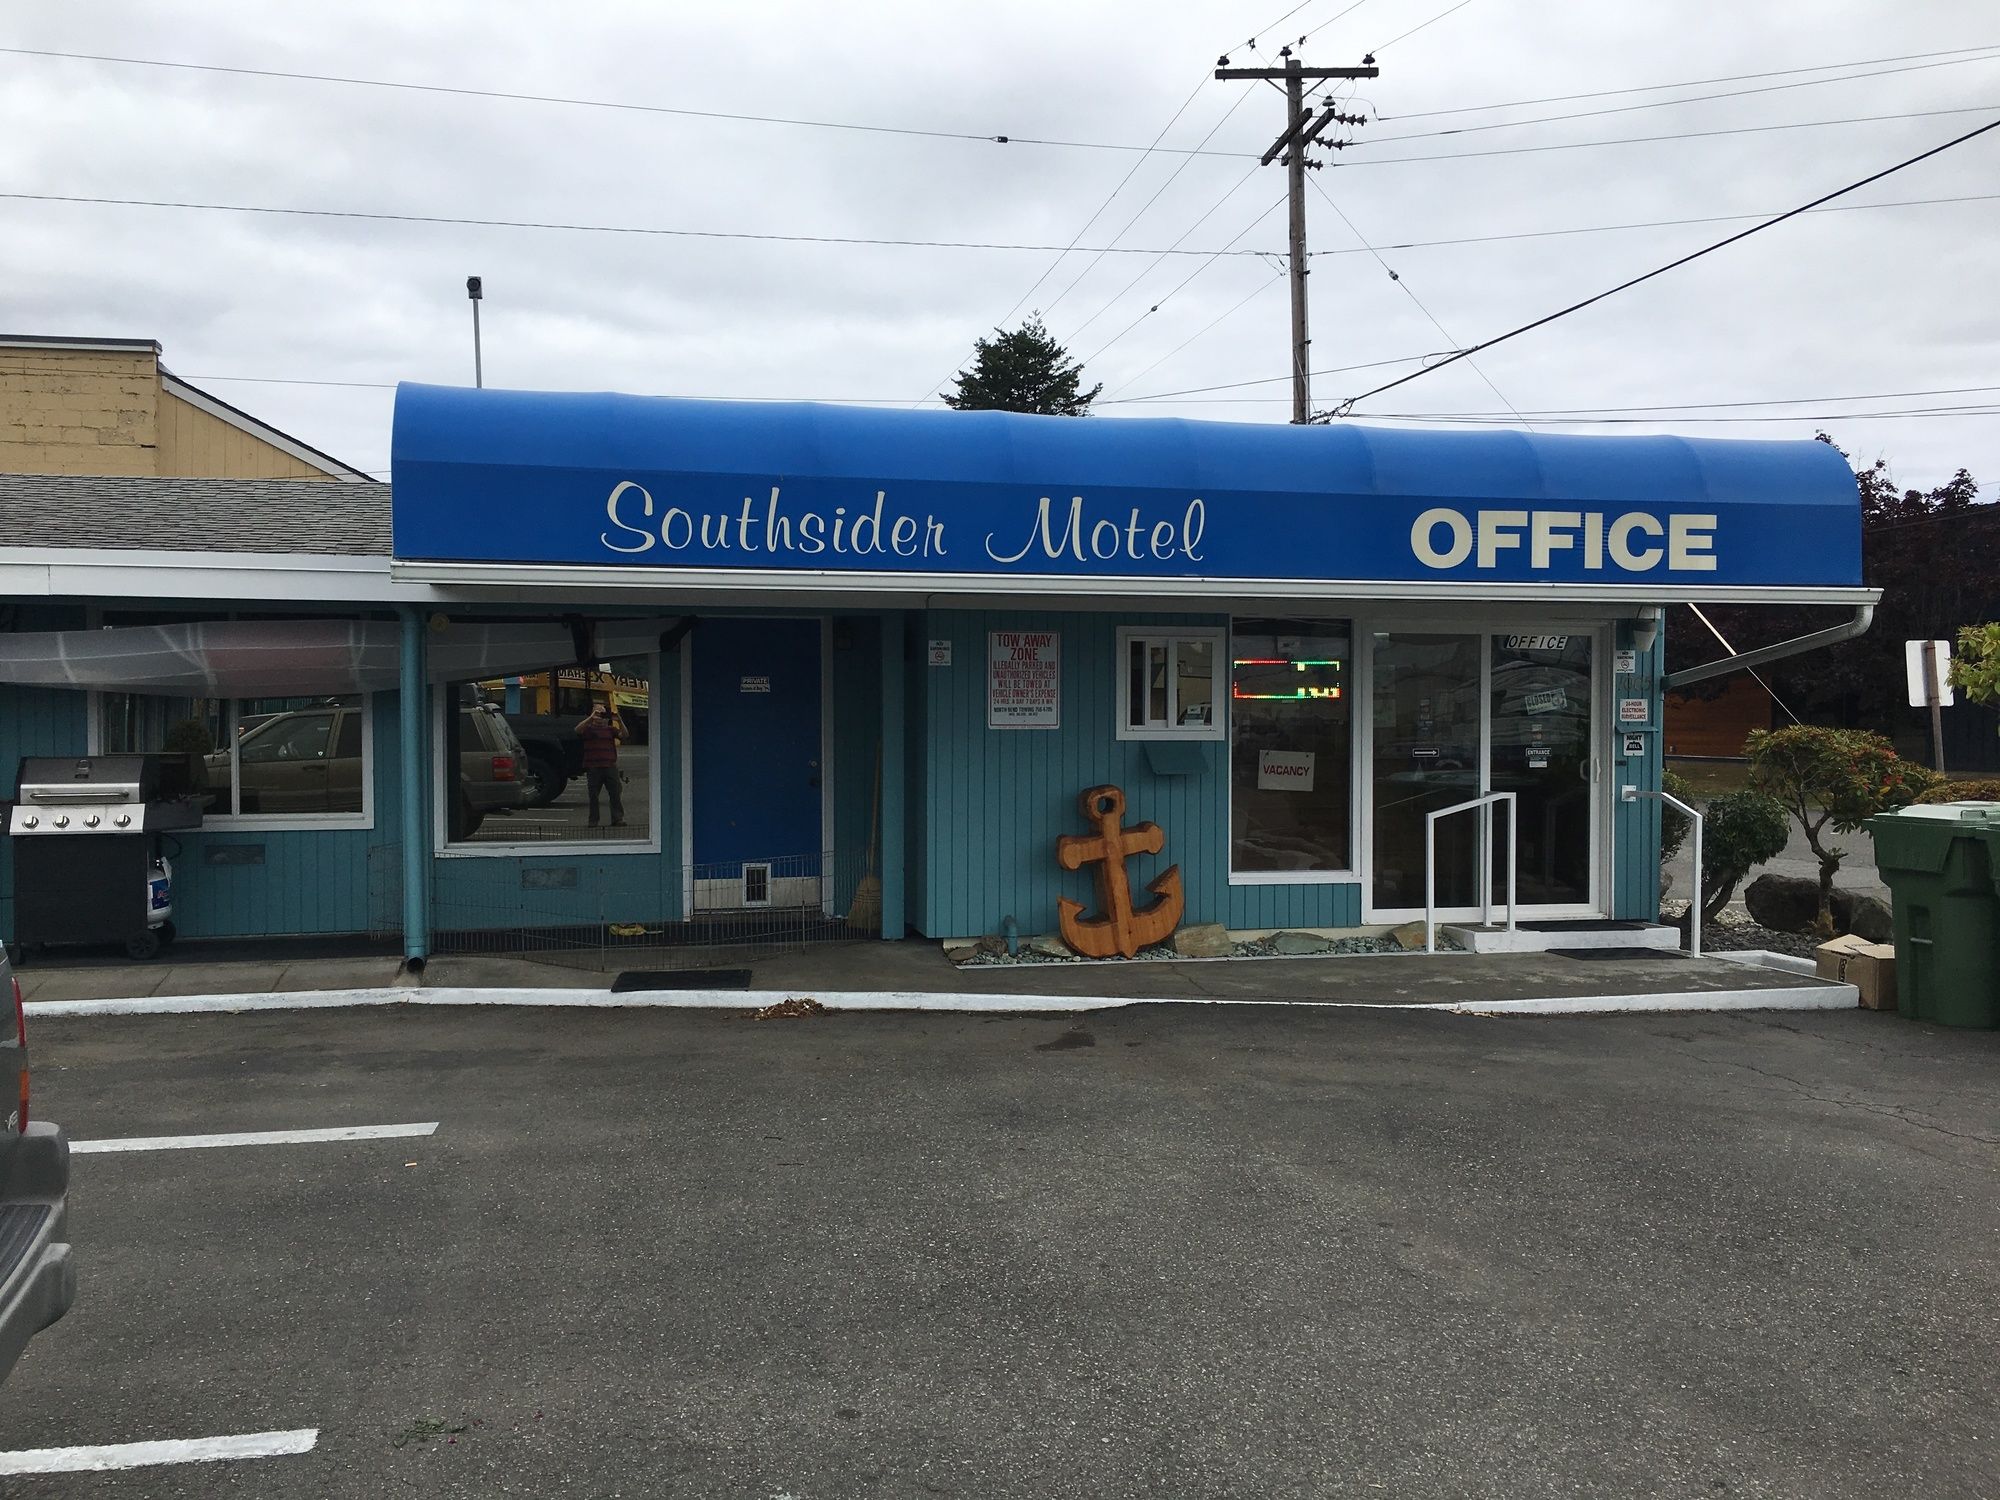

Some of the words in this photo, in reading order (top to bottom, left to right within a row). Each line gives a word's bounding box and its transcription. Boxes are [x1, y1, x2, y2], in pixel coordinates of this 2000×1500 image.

[601, 481, 947, 557] Southsider
[985, 497, 1205, 563] Motel
[1410, 508, 1718, 572] OFFICE
[996, 634, 1020, 647] TOW
[1024, 634, 1052, 648] AWAY
[1508, 635, 1566, 649] OFFICE
[1010, 647, 1038, 660] ZONE
[993, 661, 1021, 669] ILLEGALLY
[1022, 661, 1043, 669] PARKED
[1044, 661, 1056, 669] AND
[993, 670, 1031, 679] UNAUTHORIZED
[1032, 670, 1056, 679] VEHICLES
[998, 680, 1011, 688] WILL
[1013, 680, 1021, 688] BE
[1023, 680, 1042, 688] TOWED
[1044, 680, 1051, 688] AT
[993, 689, 1011, 698] VEHICLE
[1035, 689, 1056, 698] EXPENSE
[1263, 764, 1310, 776] VACANCY
